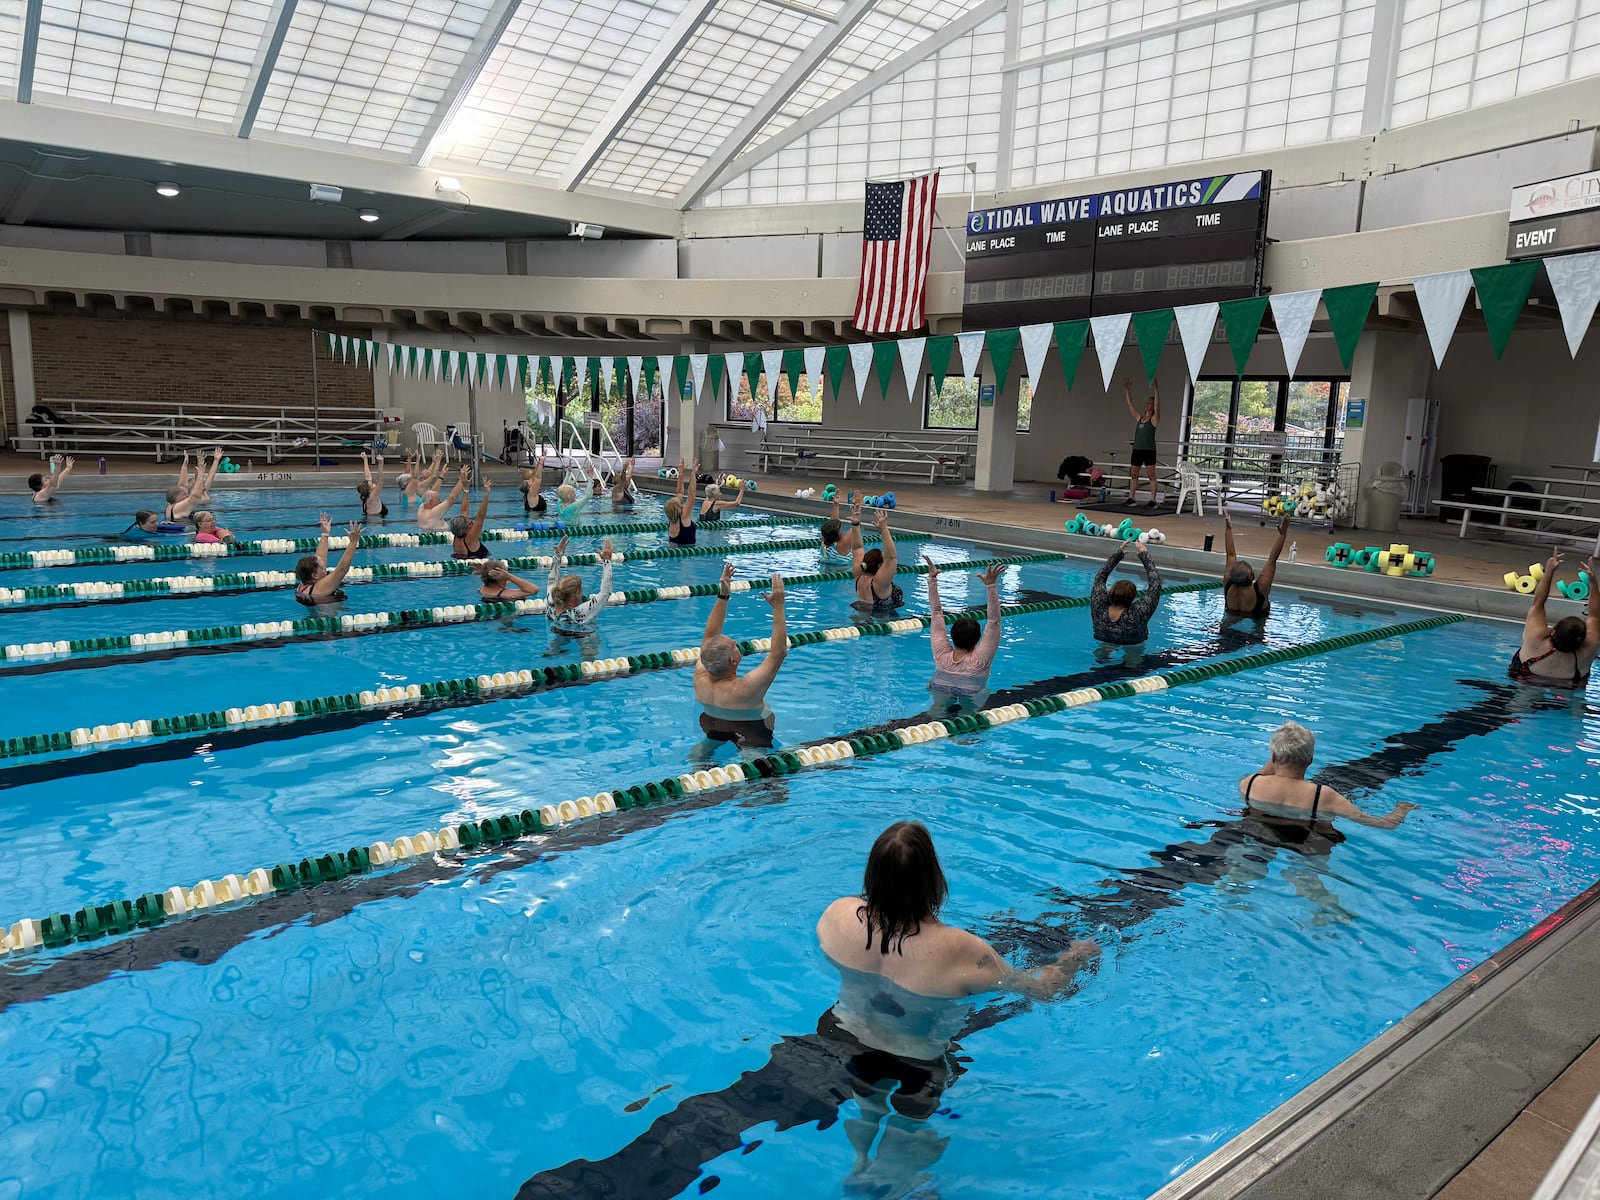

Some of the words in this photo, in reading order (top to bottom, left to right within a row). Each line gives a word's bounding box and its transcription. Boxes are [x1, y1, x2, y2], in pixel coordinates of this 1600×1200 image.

[986, 206, 1034, 230] TIDAL
[1040, 198, 1091, 224] WAVE
[1100, 181, 1202, 215] AQUATICS
[1098, 224, 1124, 238] LANE
[1127, 220, 1160, 235] PLACE
[1195, 212, 1222, 227] TIME
[966, 240, 987, 252] LANE
[990, 236, 1016, 250] PLACE
[1045, 230, 1067, 243] TIME
[1515, 228, 1556, 248] EVENT
